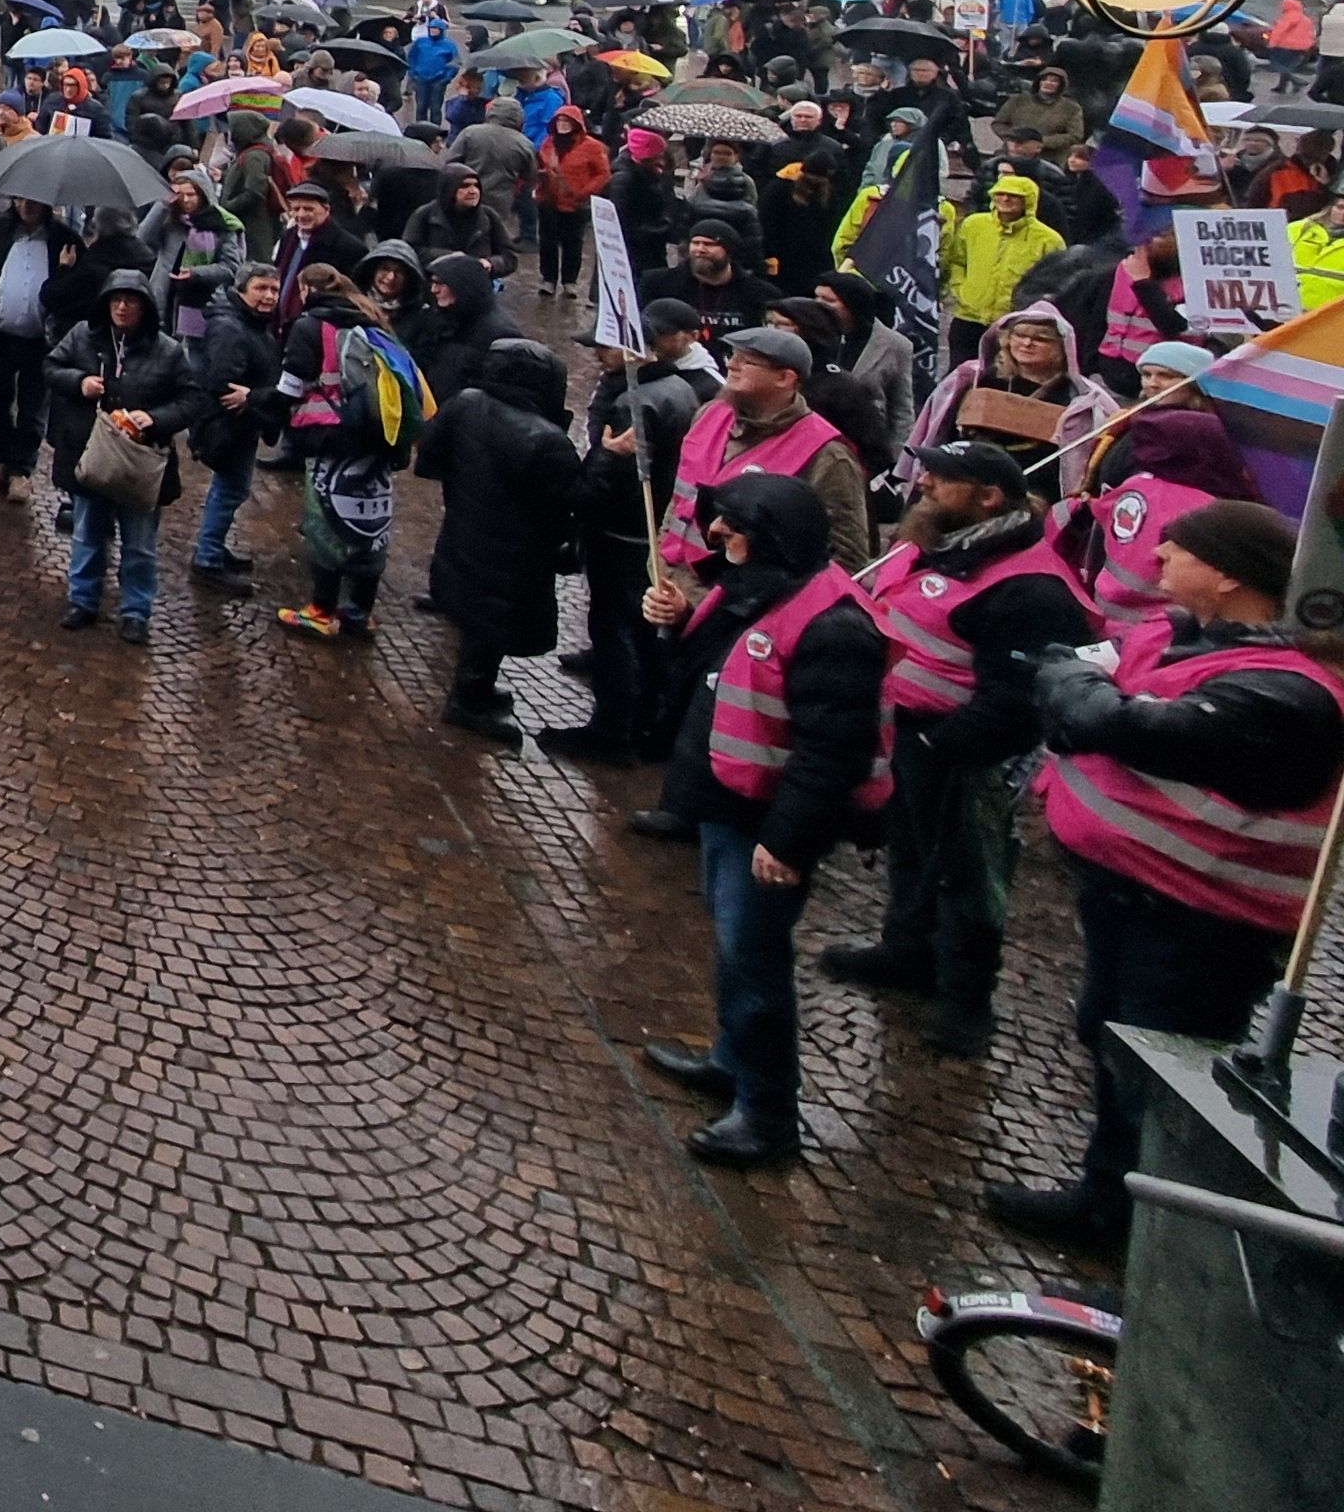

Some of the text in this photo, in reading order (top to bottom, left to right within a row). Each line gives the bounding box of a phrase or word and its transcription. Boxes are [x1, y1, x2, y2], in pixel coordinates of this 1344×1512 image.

[1196, 217, 1267, 241] BJÖRN
[1200, 241, 1272, 267] HÖCKE
[1205, 279, 1279, 312] NAZI
